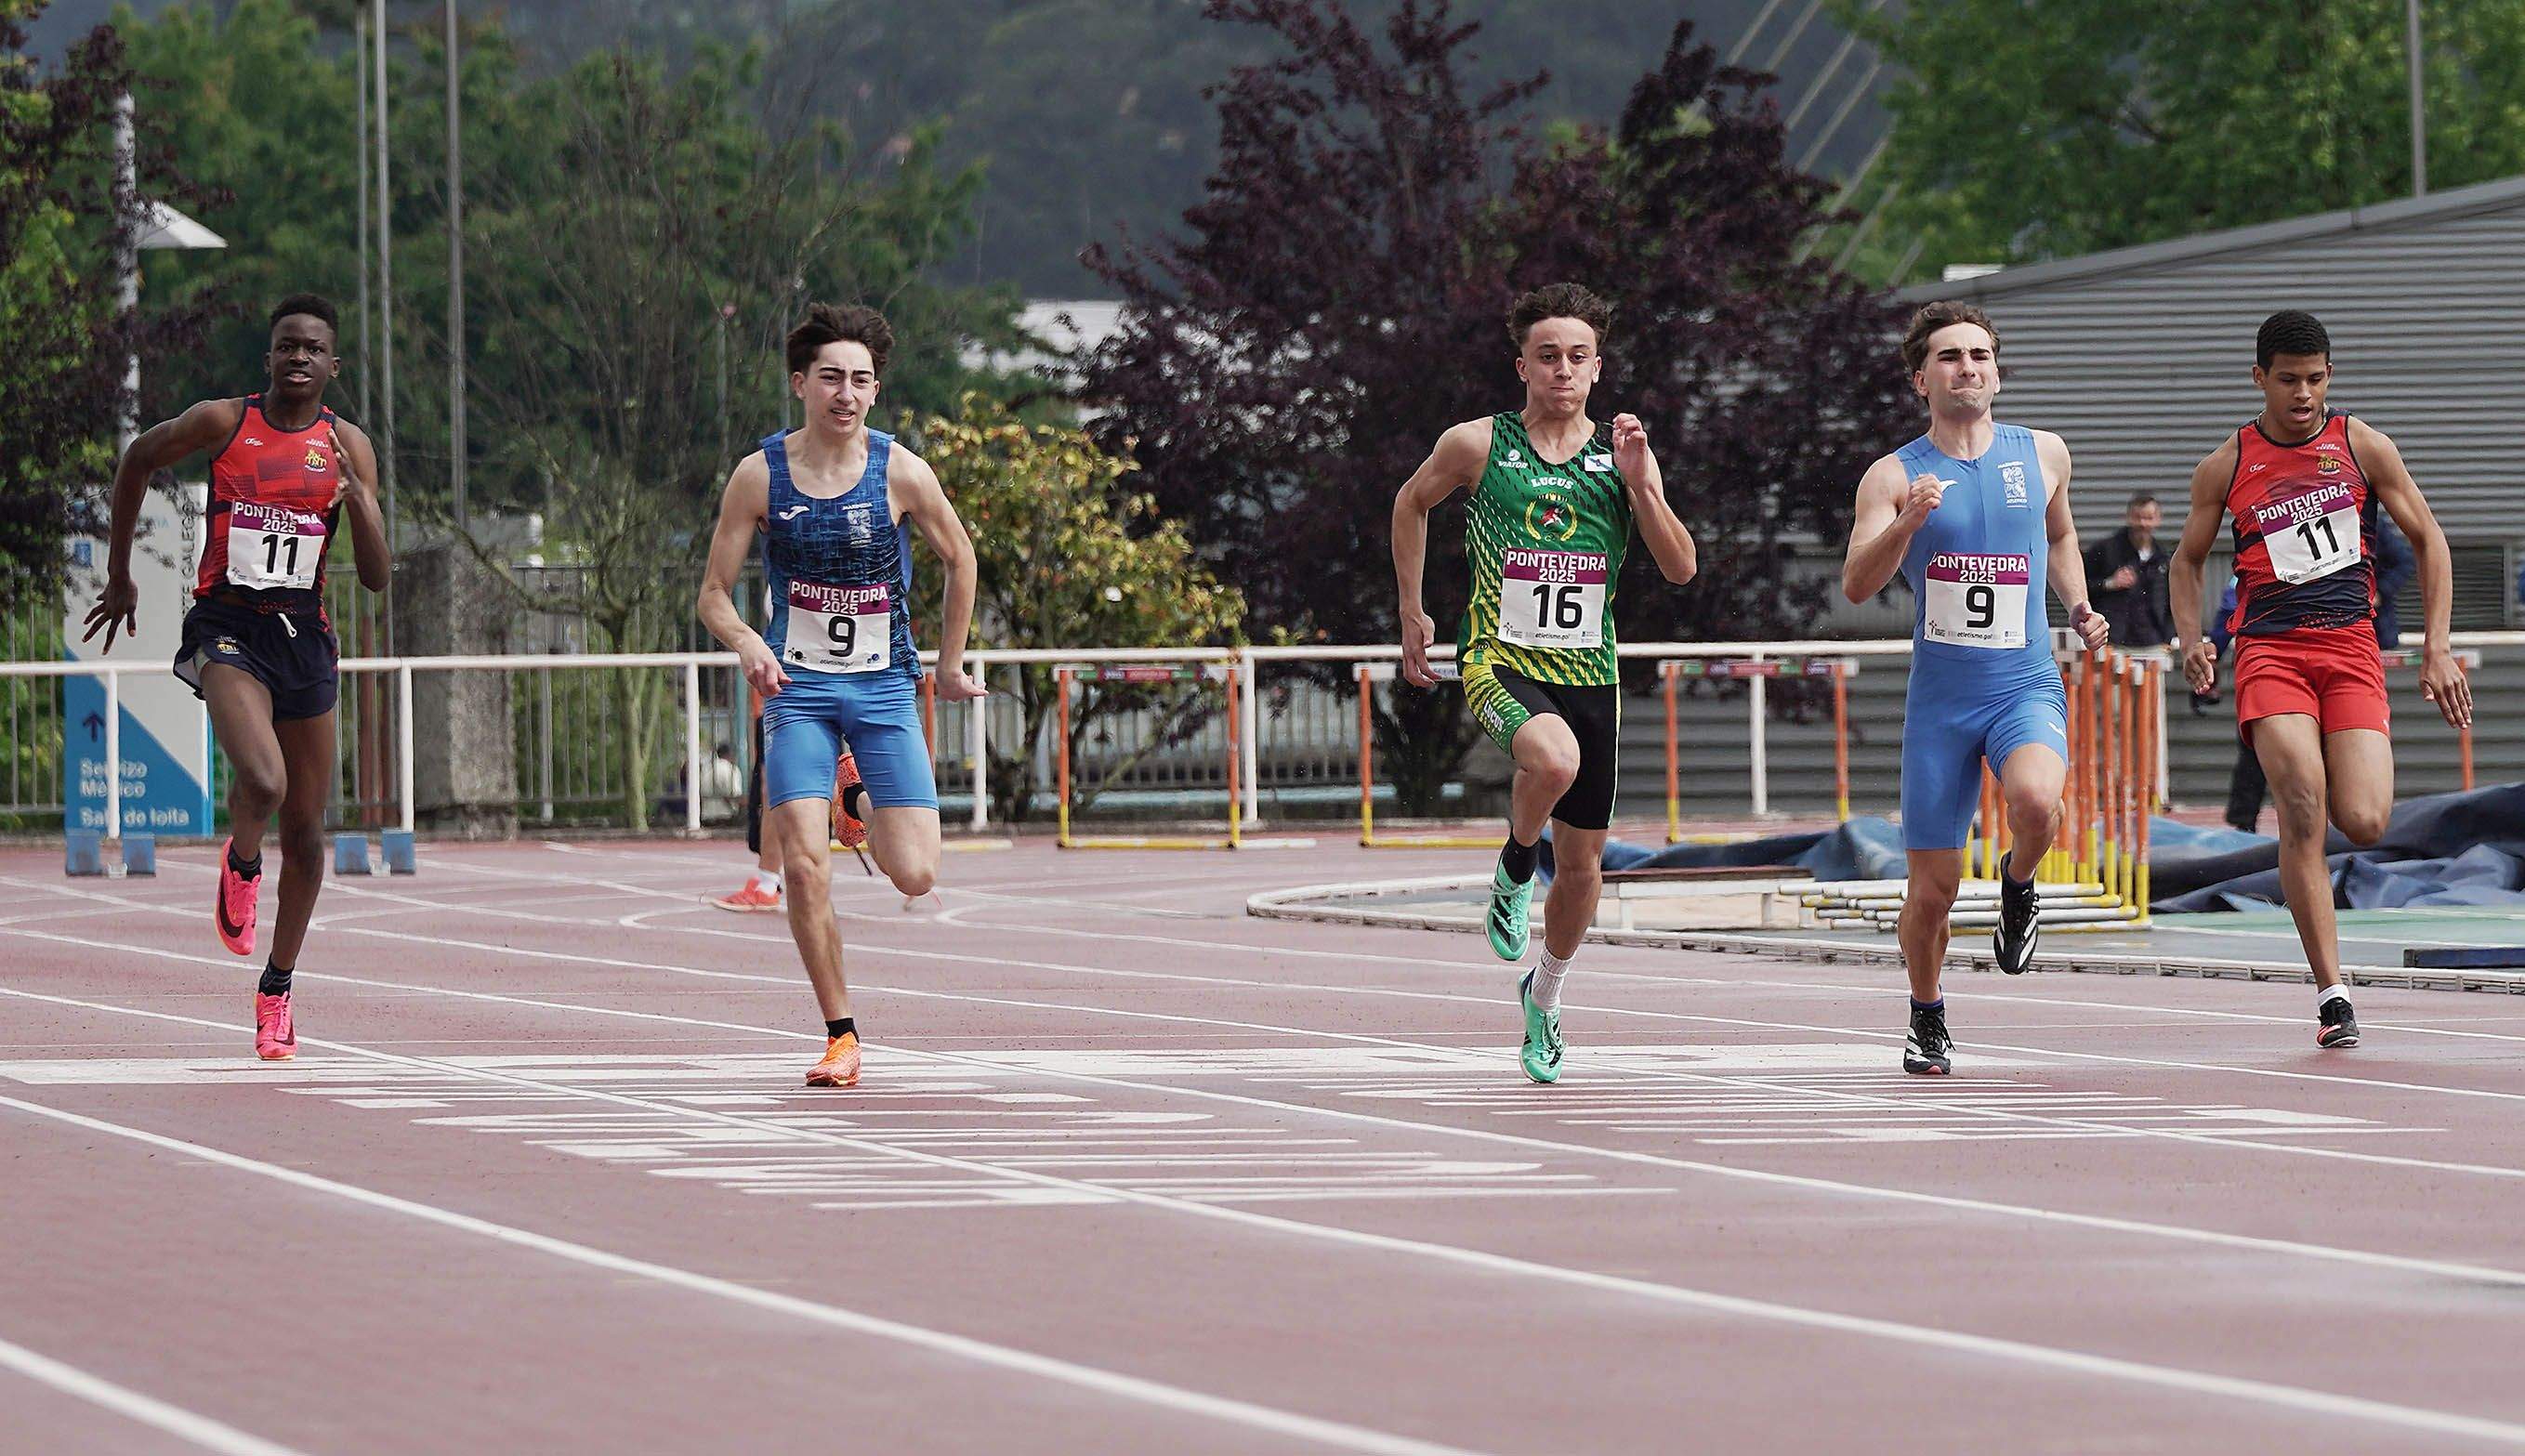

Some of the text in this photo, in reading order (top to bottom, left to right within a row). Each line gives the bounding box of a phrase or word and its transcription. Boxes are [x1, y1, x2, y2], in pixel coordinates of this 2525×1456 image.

[1531, 476, 1574, 490] LUCUS
[2256, 483, 2350, 524] PONTEVEDRA
[262, 518, 297, 533] 2025
[2291, 505, 2323, 525] 2025
[2296, 516, 2340, 562] 11
[262, 533, 299, 576] 11
[1506, 550, 1607, 571] PONTEVEDRA
[1538, 568, 1576, 583] 2025
[1959, 570, 1996, 584] 2025
[791, 581, 888, 603] PONTEVEDRA
[822, 599, 859, 615] 2025
[1532, 584, 1584, 629] 16
[1966, 584, 1995, 629] 9
[828, 615, 856, 658] 9
[1483, 699, 1505, 732] LUCUS
